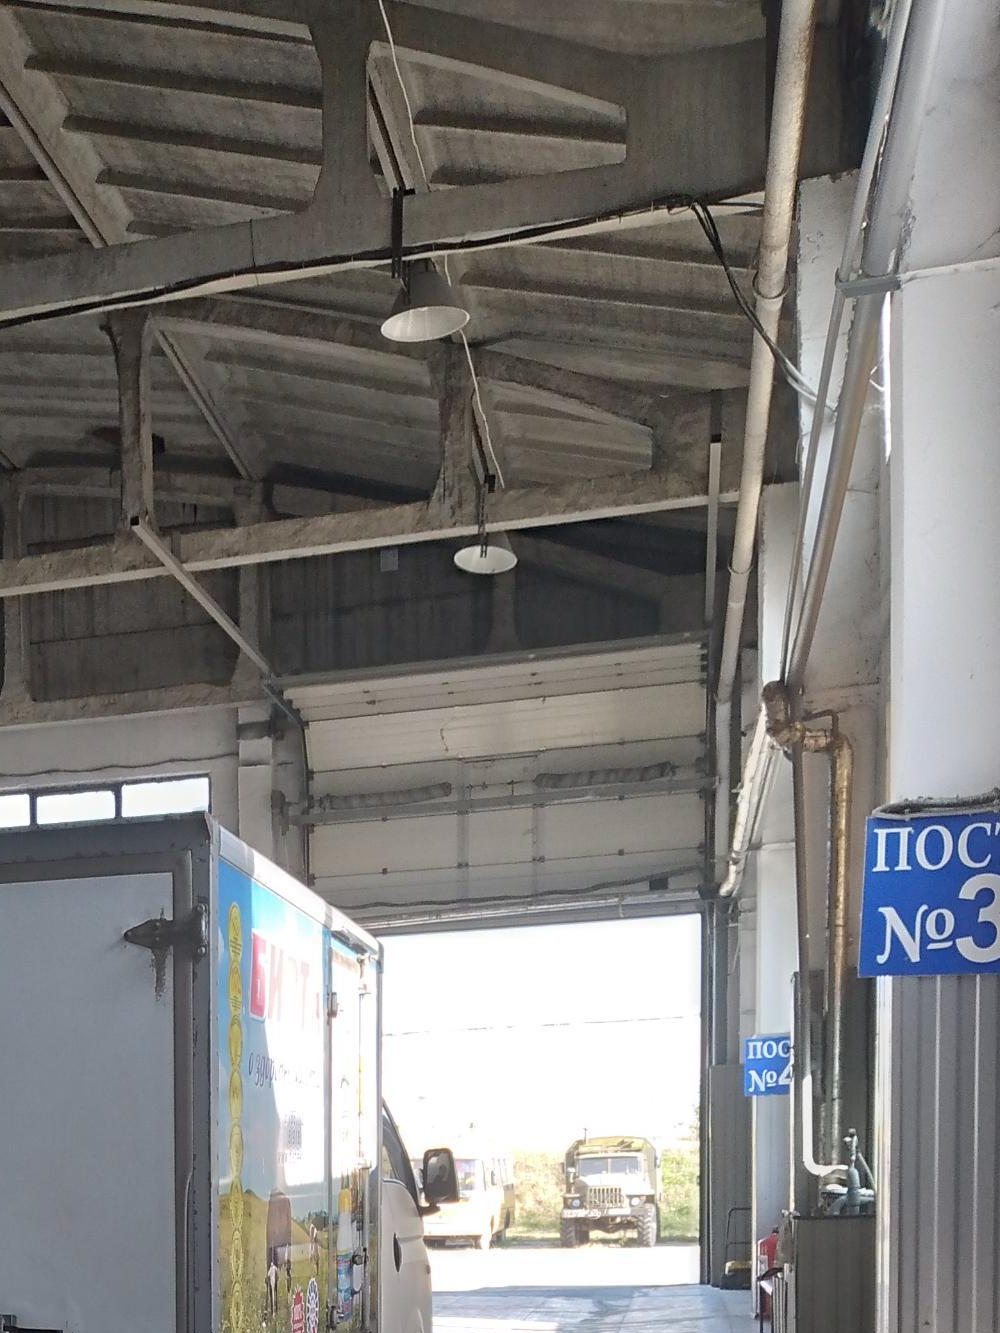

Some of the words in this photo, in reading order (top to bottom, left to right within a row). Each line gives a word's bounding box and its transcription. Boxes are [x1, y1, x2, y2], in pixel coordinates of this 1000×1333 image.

[872, 823, 1000, 872] ПОС
[876, 873, 1000, 964] №3
[747, 1040, 790, 1059] ПОС
